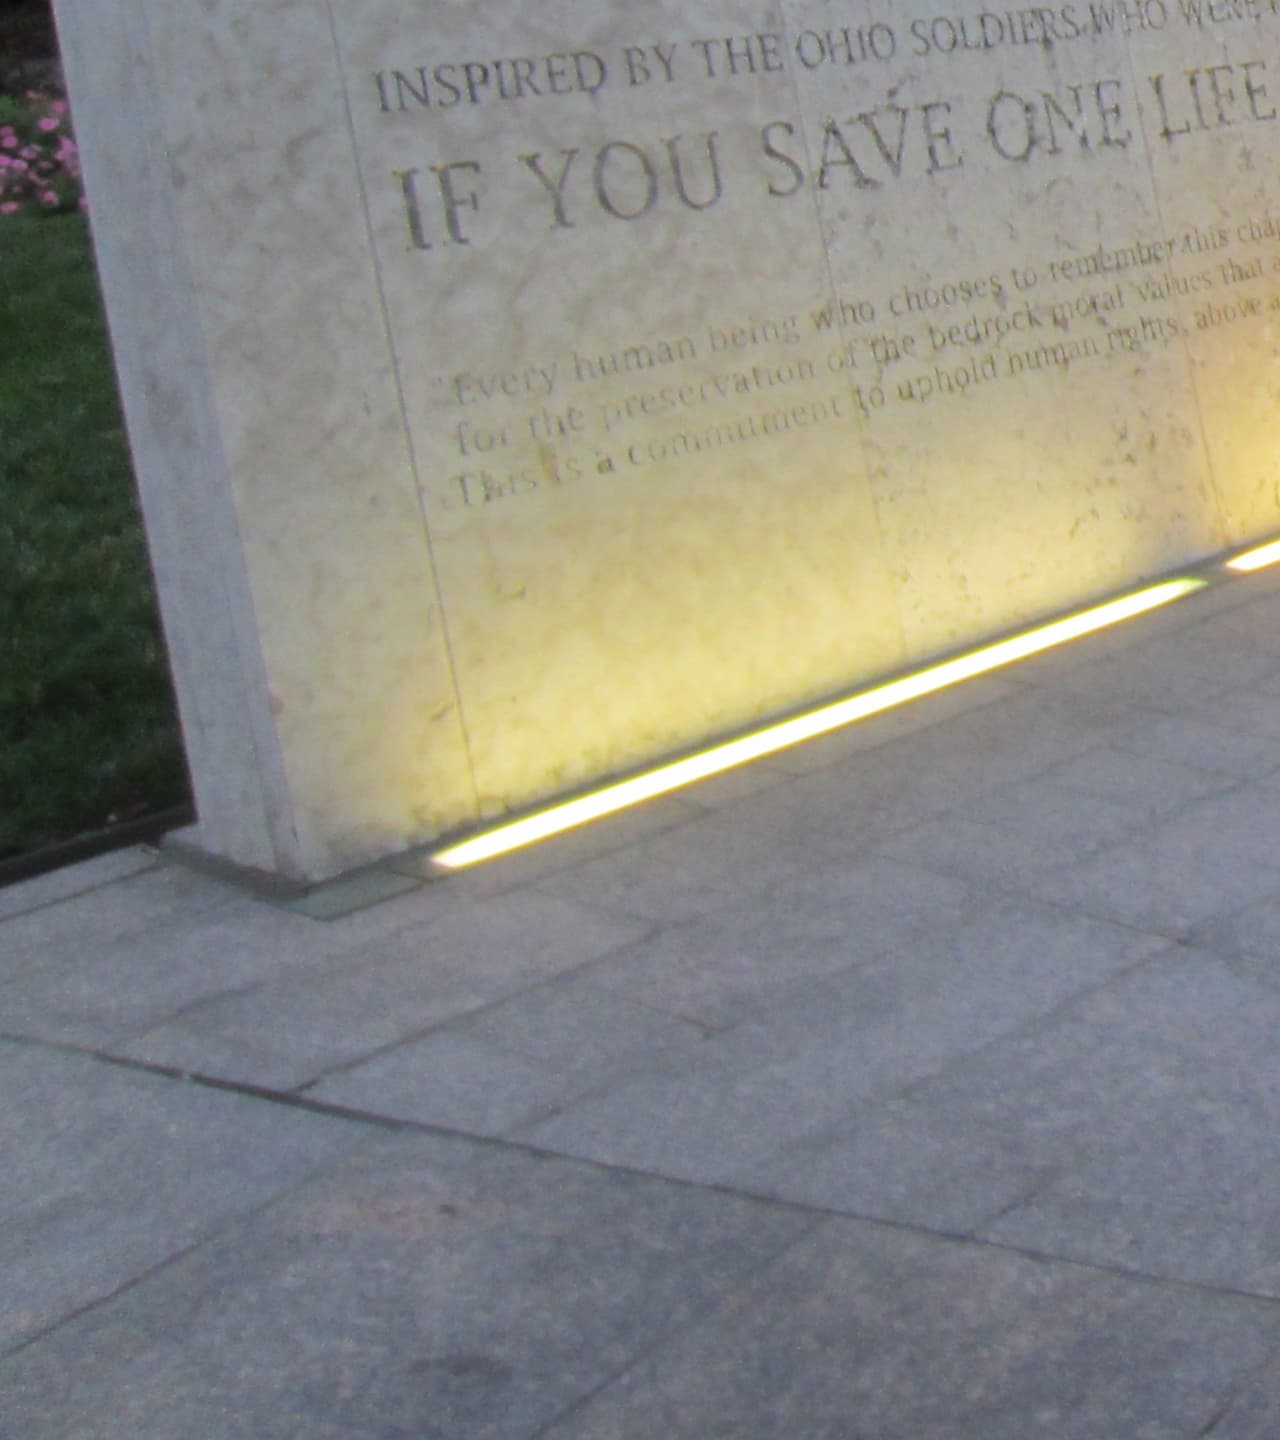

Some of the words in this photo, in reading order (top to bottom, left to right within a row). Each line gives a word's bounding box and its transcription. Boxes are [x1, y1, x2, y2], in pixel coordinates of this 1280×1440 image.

[371, 50, 609, 113] INSPIRED
[623, 43, 678, 87] BY
[690, 33, 784, 79] THE
[795, 22, 896, 69] OHIO
[909, 4, 1081, 57] SOLDIERS
[392, 160, 481, 251] IF
[516, 130, 723, 230] YOU
[760, 100, 965, 198] SAVE
[986, 79, 1133, 163] ONE
[454, 418, 513, 458] for
[527, 405, 586, 442] the
[600, 357, 817, 433] preservation
[825, 334, 858, 371] of
[868, 331, 917, 365] the
[927, 300, 1044, 353] bedrock
[1049, 286, 1126, 328] moral
[1129, 270, 1214, 304] values
[1217, 256, 1266, 287] that
[570, 335, 699, 383] human
[706, 314, 802, 355] being
[811, 297, 876, 334] who
[887, 272, 1005, 318] chooses
[1010, 266, 1039, 293] to
[1047, 237, 1177, 283] remember
[1182, 225, 1231, 256] this
[450, 466, 539, 507] This
[549, 455, 584, 486] is
[594, 453, 617, 477] a
[626, 397, 841, 467] commitment
[852, 382, 886, 419] to
[896, 353, 1000, 404] uphold
[1005, 333, 1100, 377] human
[1194, 295, 1264, 332] above
